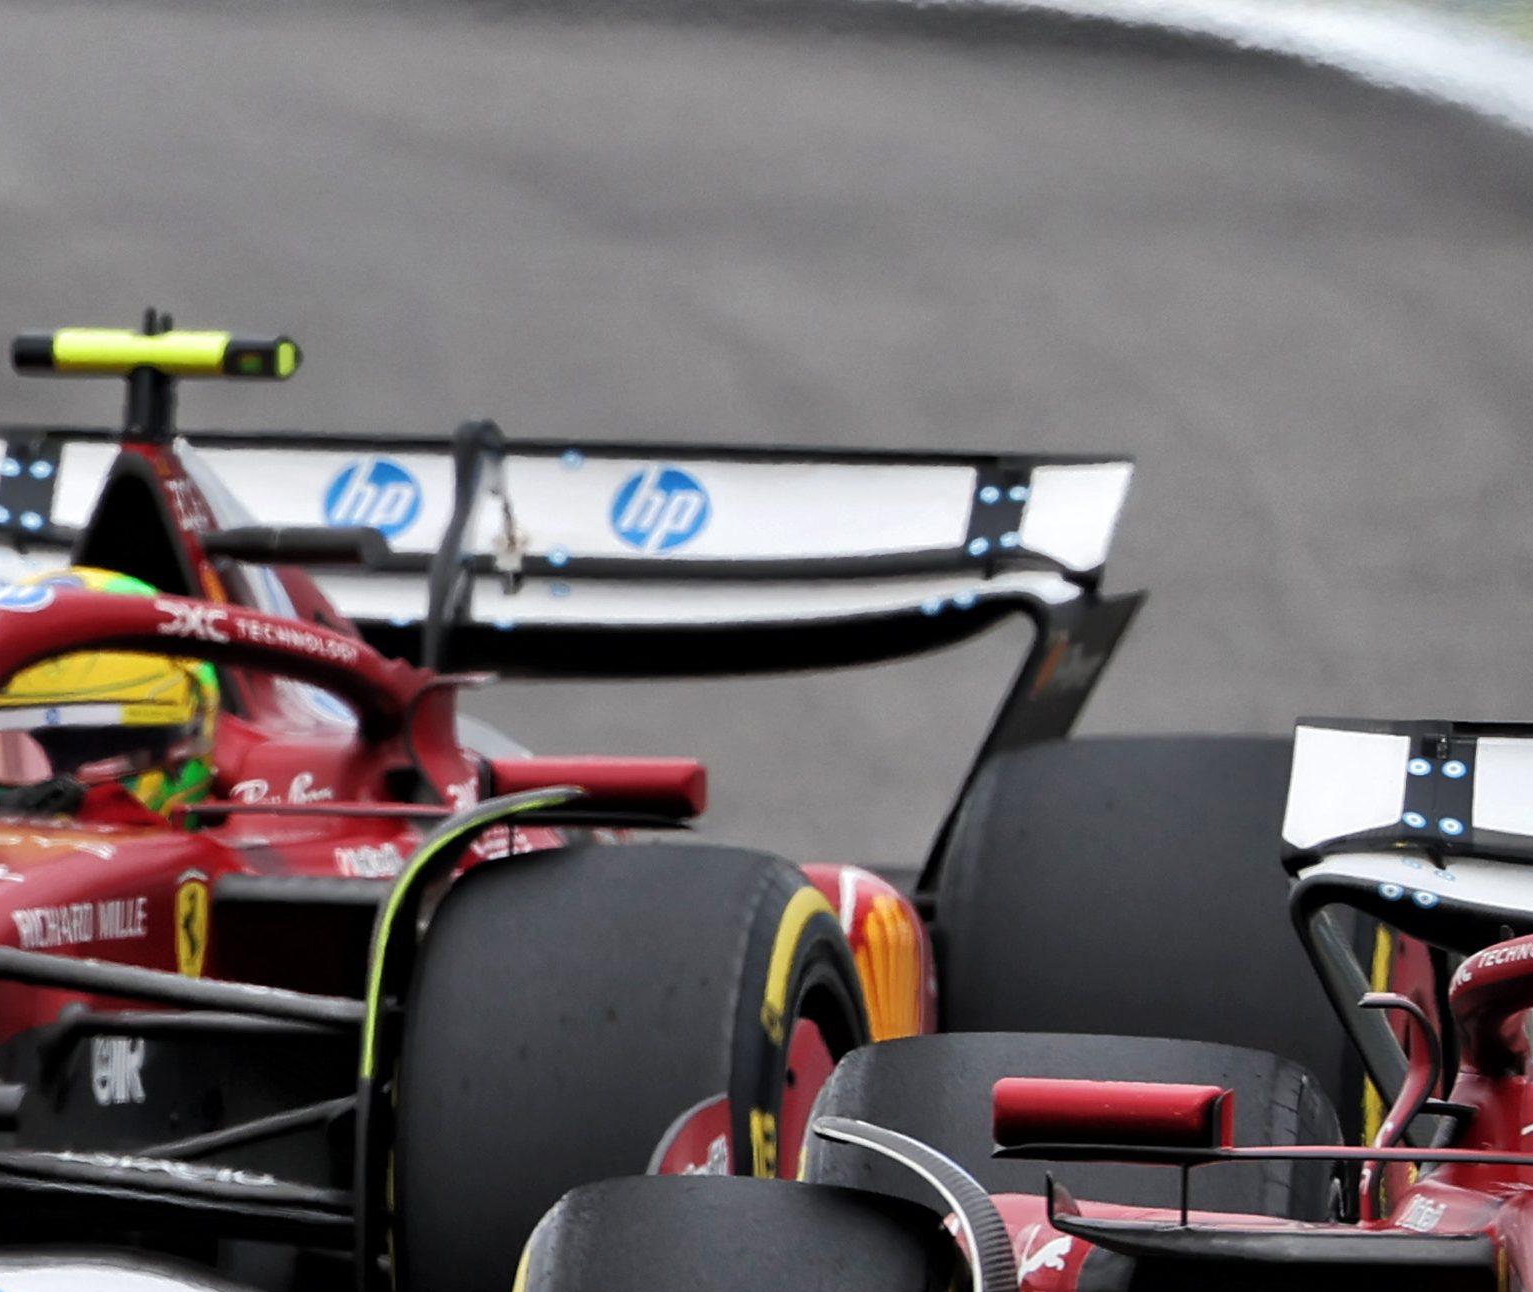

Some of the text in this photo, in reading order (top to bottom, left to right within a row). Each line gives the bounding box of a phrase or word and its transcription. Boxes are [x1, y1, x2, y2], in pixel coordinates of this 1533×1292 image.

[328, 458, 418, 537] hp
[613, 466, 708, 552] hp
[154, 599, 229, 643] DXC
